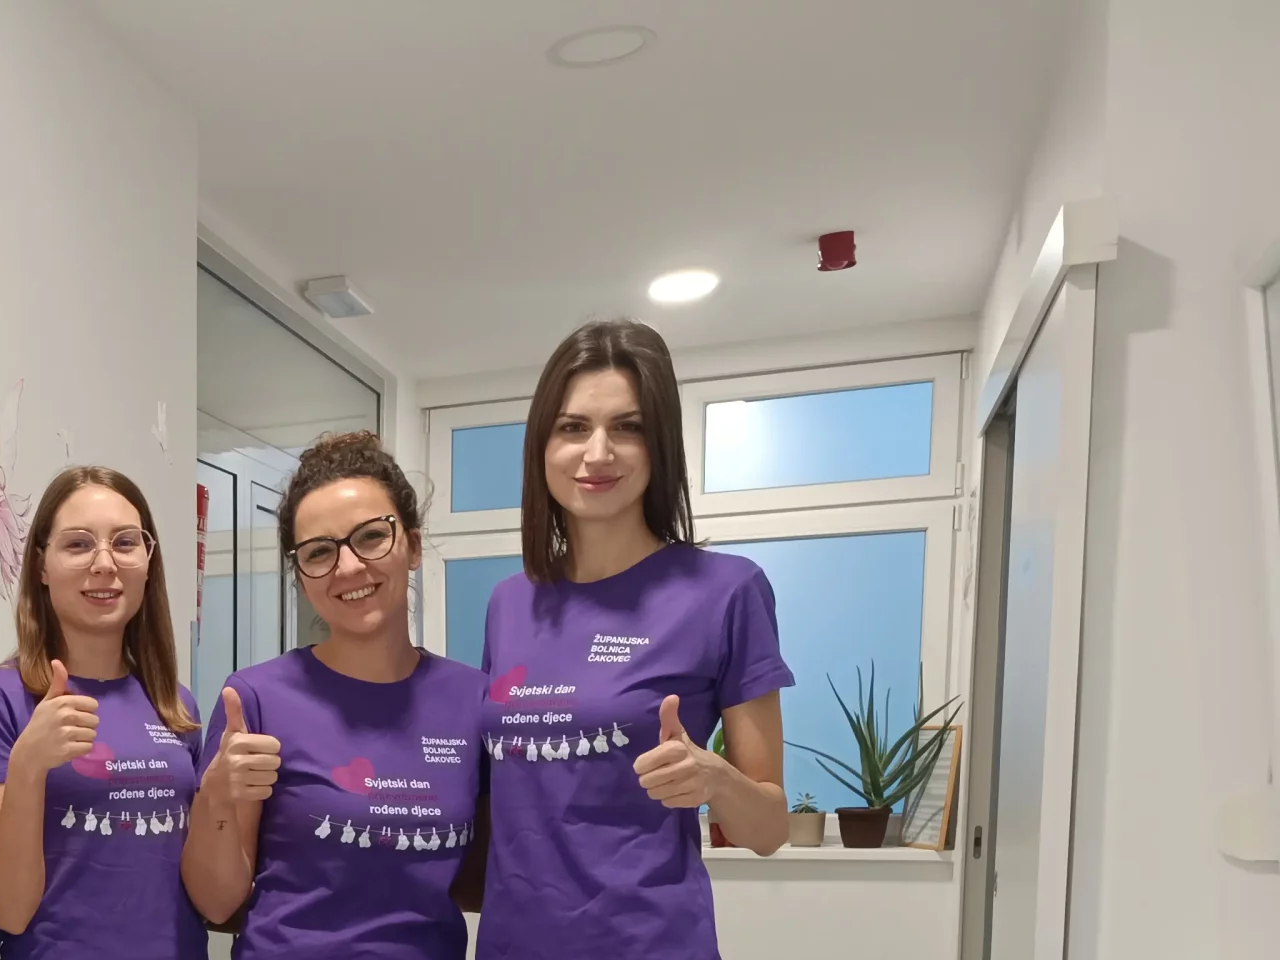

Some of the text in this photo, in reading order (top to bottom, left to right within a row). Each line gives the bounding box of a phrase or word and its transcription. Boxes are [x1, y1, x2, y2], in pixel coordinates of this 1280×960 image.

[593, 633, 650, 645] ŽUPANIJSKA
[590, 645, 631, 654] BOLNICA
[587, 653, 632, 663] ČAKOVEC
[508, 684, 576, 698] Svjetski dan
[501, 712, 573, 725] rođene djece
[421, 736, 468, 746] ŽUPANIJSKA
[423, 746, 457, 755] BOLNICA
[424, 754, 462, 764] ČAKOVEC
[105, 759, 169, 772] Svjetski dan
[364, 777, 431, 790] Svjetski dan
[108, 787, 176, 800] rođene djece
[369, 804, 442, 818] rođene djece
